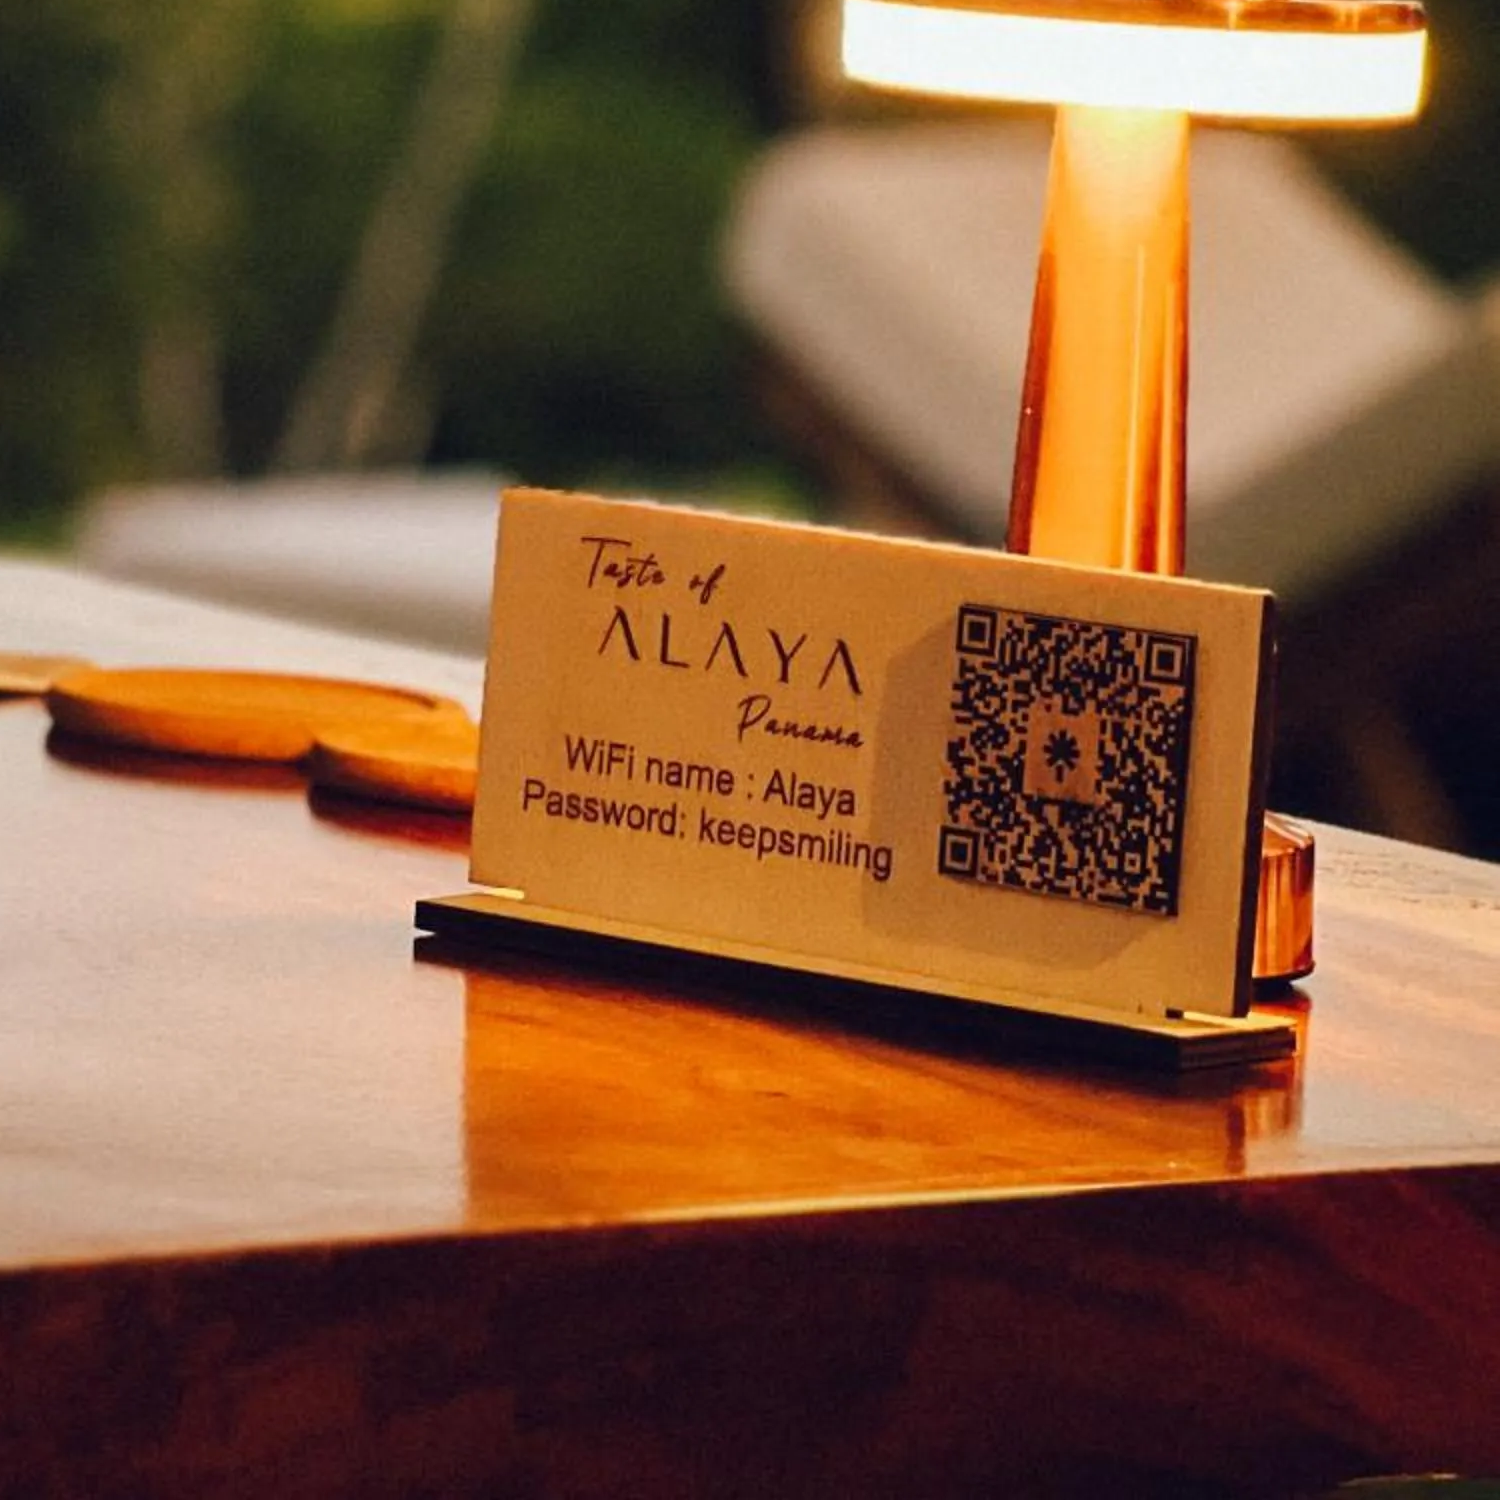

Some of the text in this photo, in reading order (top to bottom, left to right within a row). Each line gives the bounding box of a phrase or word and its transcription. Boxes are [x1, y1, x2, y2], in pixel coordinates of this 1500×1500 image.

[581, 537, 726, 605] Taste of
[598, 605, 862, 696] ALAYA
[737, 694, 864, 750] Panama
[565, 734, 635, 781] WiFi
[646, 755, 735, 796] name
[763, 769, 856, 820] Alaya
[522, 779, 893, 882] Password: keepsmiling
